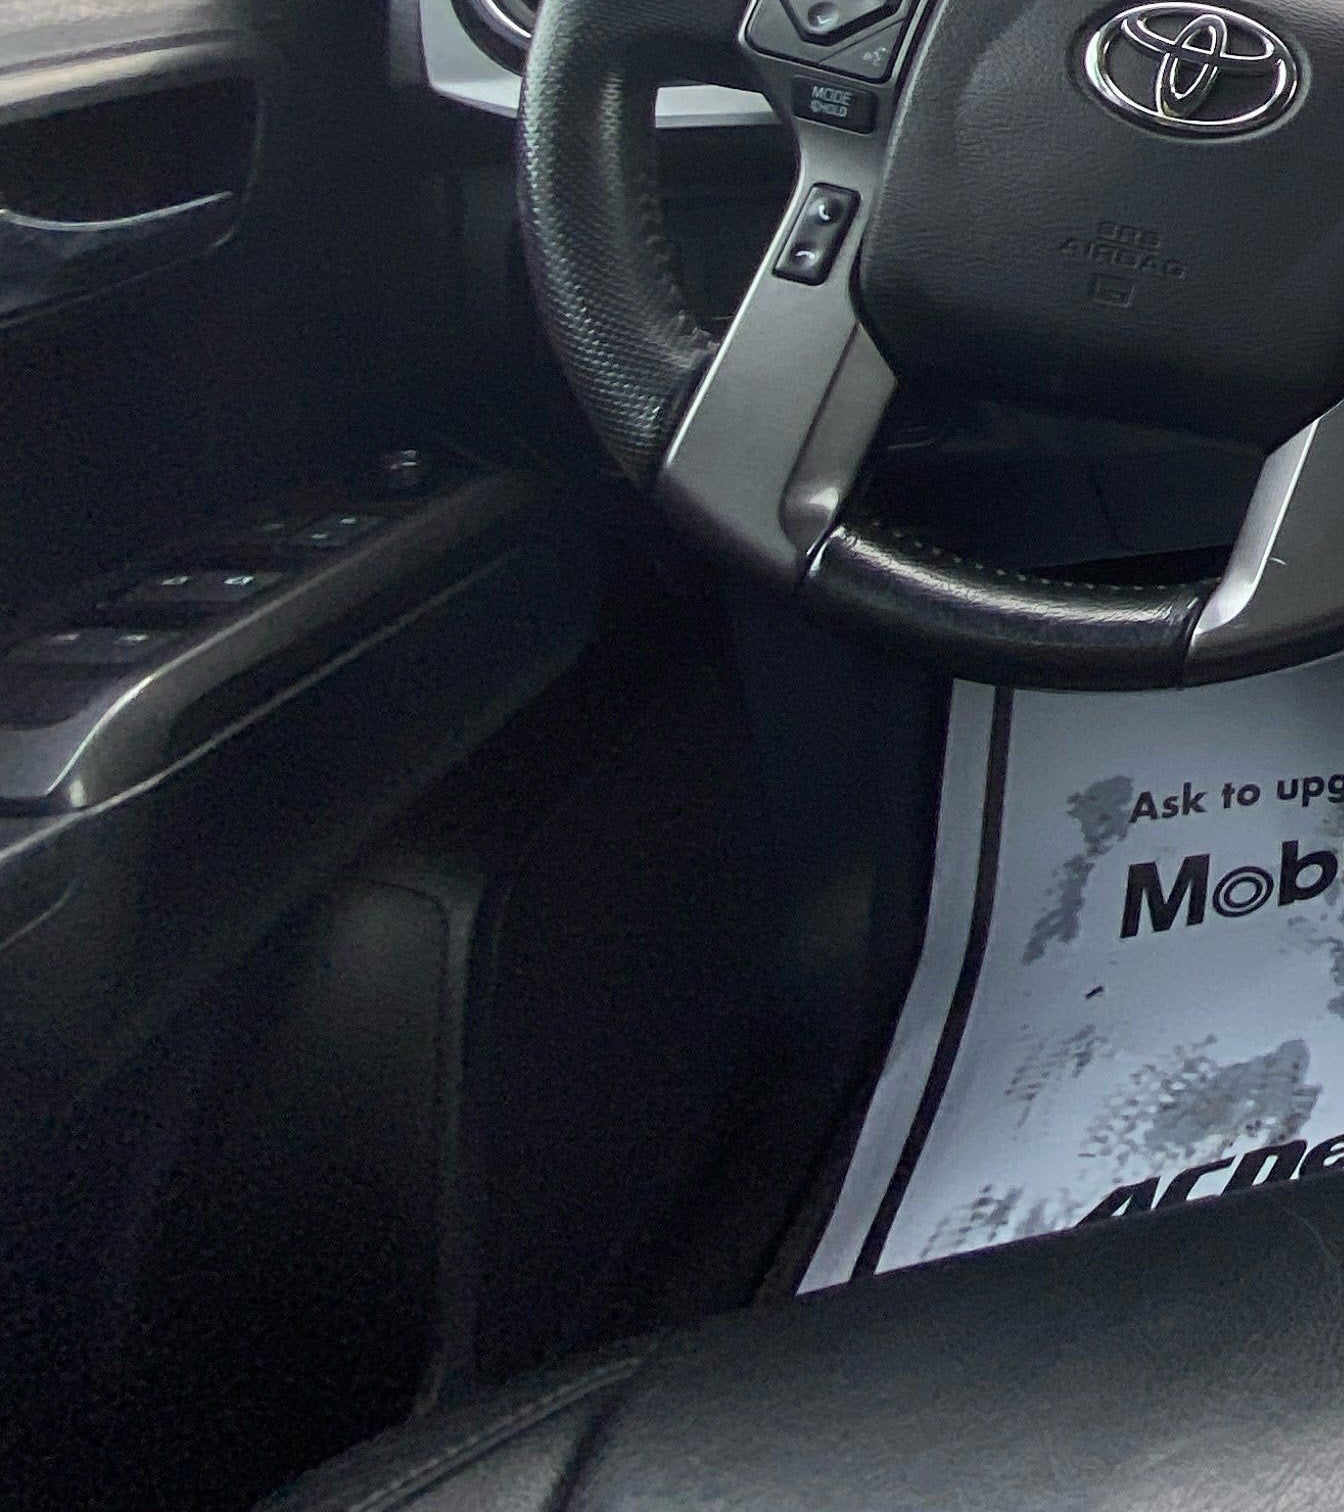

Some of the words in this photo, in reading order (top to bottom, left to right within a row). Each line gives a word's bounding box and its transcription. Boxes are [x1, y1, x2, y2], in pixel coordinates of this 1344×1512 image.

[812, 86, 852, 106] MODE
[1060, 237, 1187, 282] AIRBAG
[1129, 783, 1209, 824] Ask
[1222, 782, 1261, 809] to
